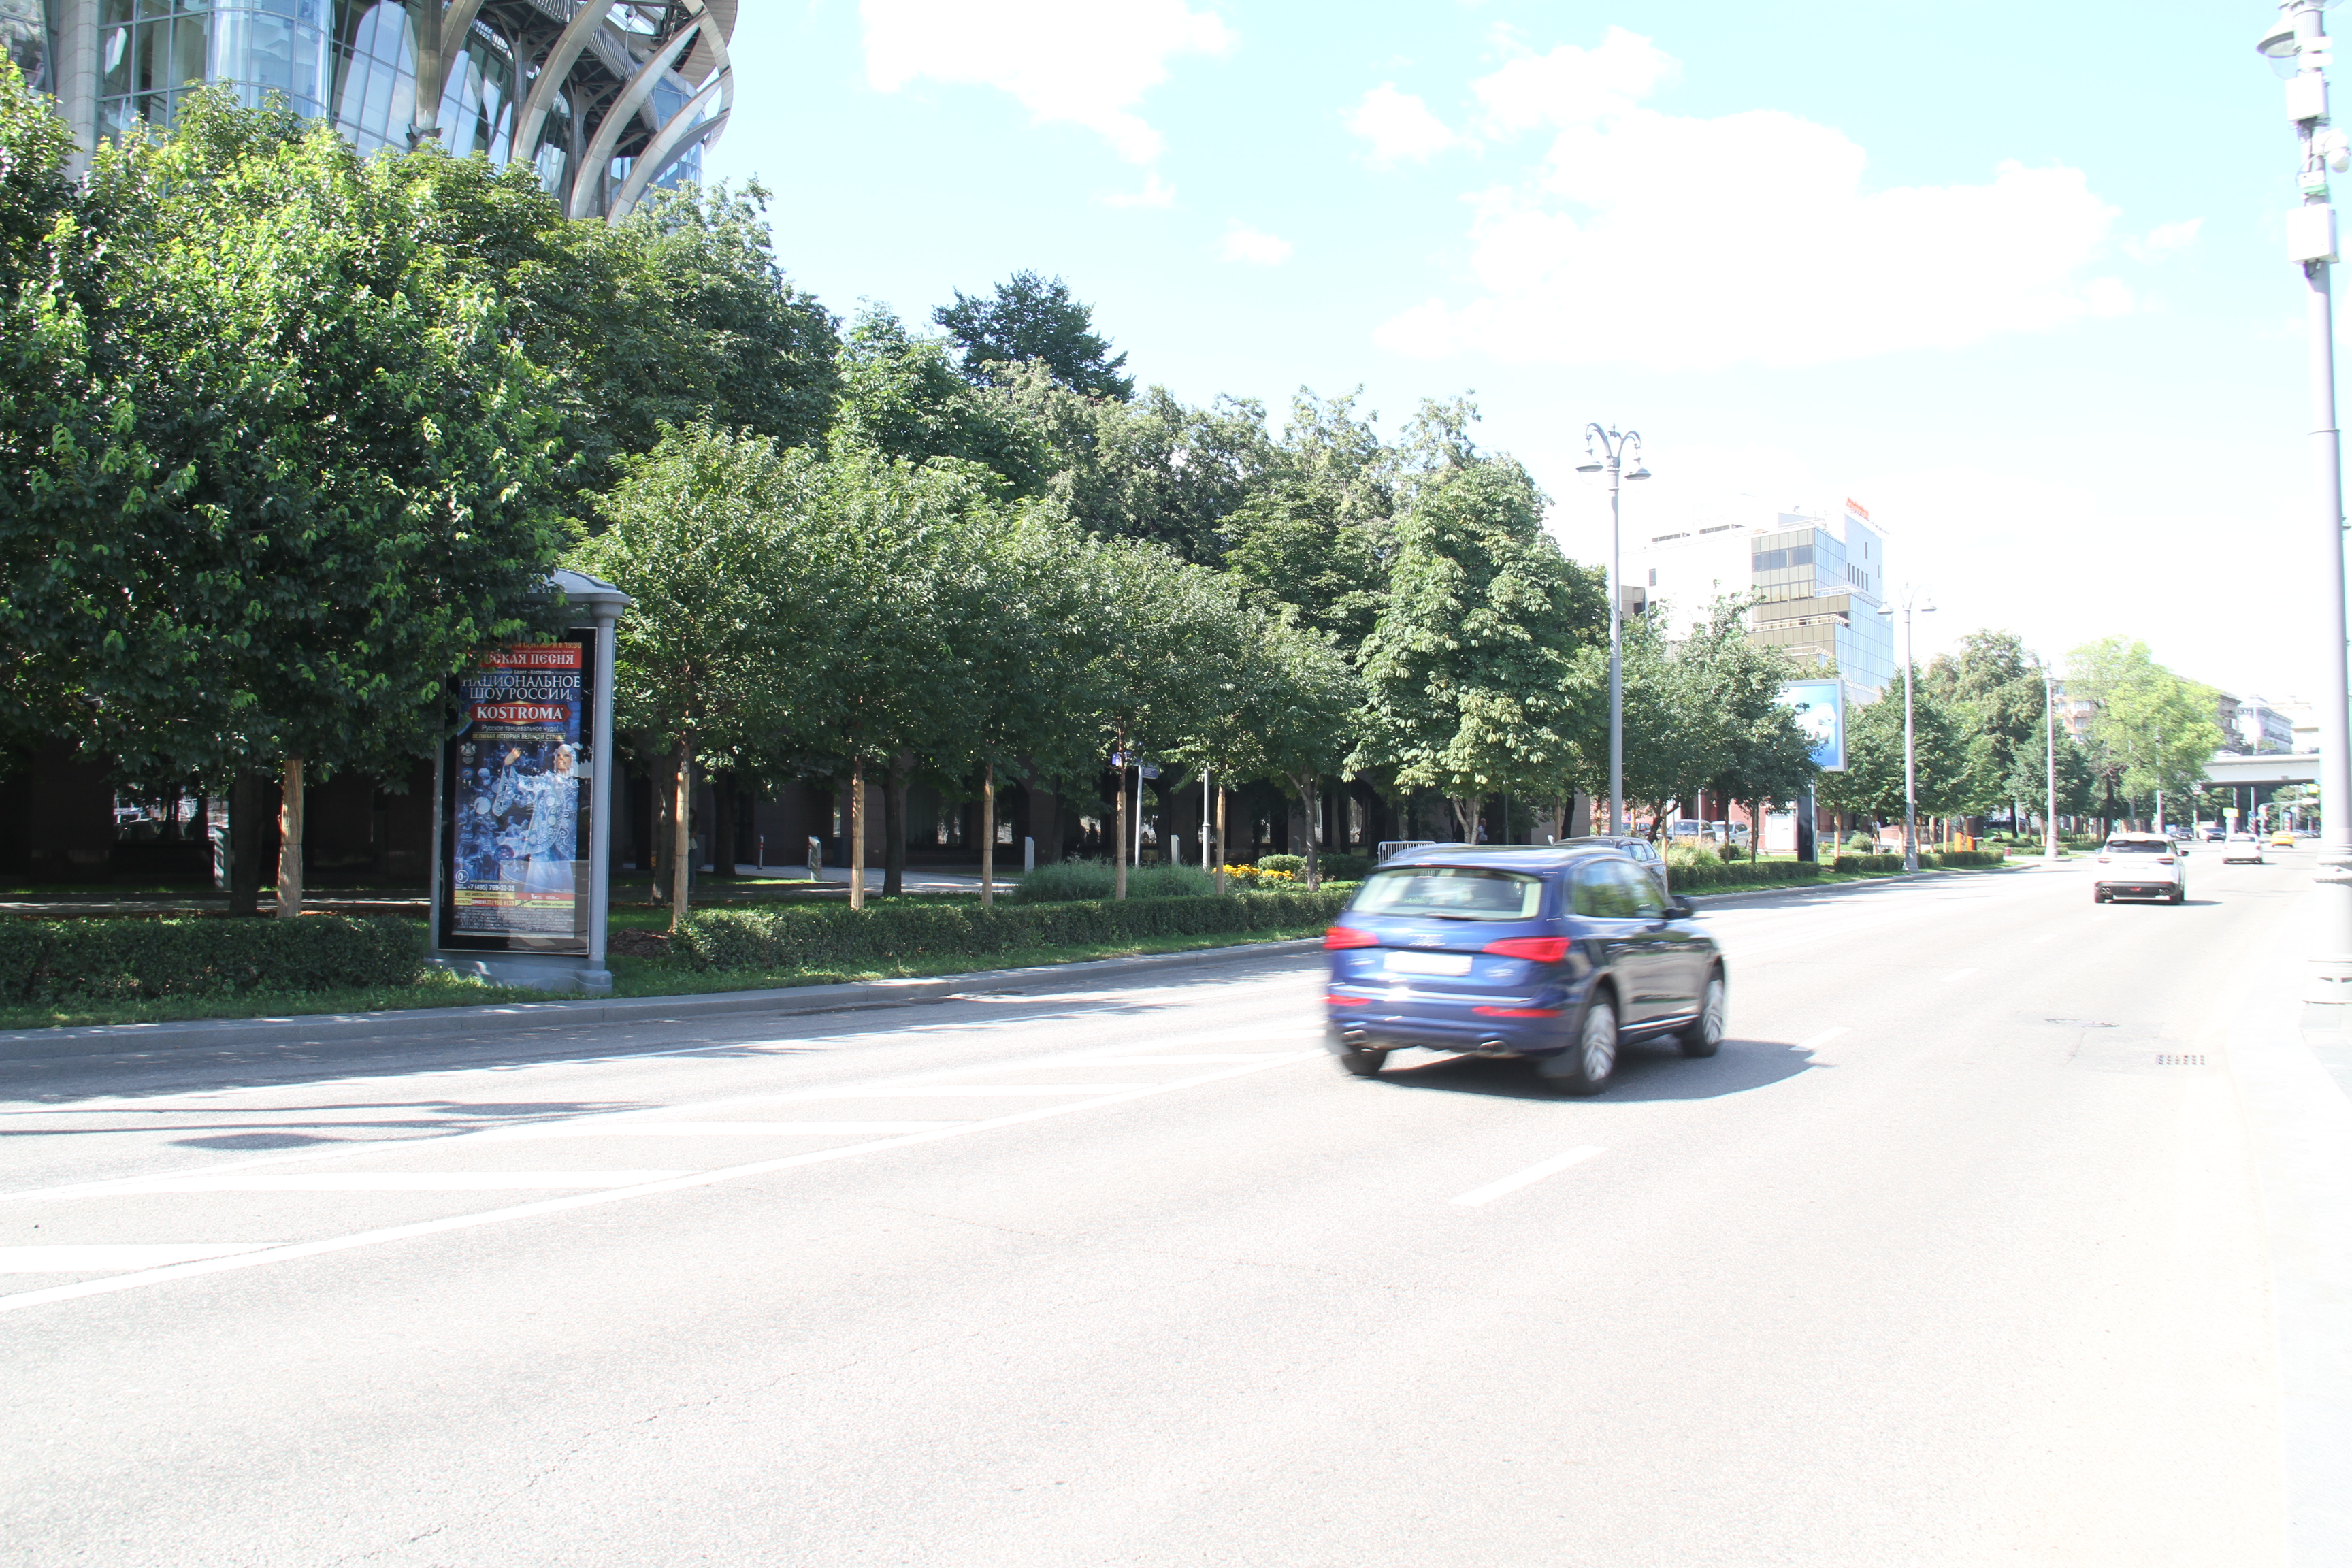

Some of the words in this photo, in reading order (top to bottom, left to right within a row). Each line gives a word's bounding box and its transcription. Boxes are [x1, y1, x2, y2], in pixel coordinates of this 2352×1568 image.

[485, 653, 527, 665] ССКАЯ
[530, 653, 574, 665] ПЕСНЯ
[462, 676, 580, 687] НАЦИОНАЛЬНОЕ
[470, 687, 505, 700] ШОУ
[509, 687, 570, 700] РОССИИ
[477, 706, 564, 719] KOSTROMA
